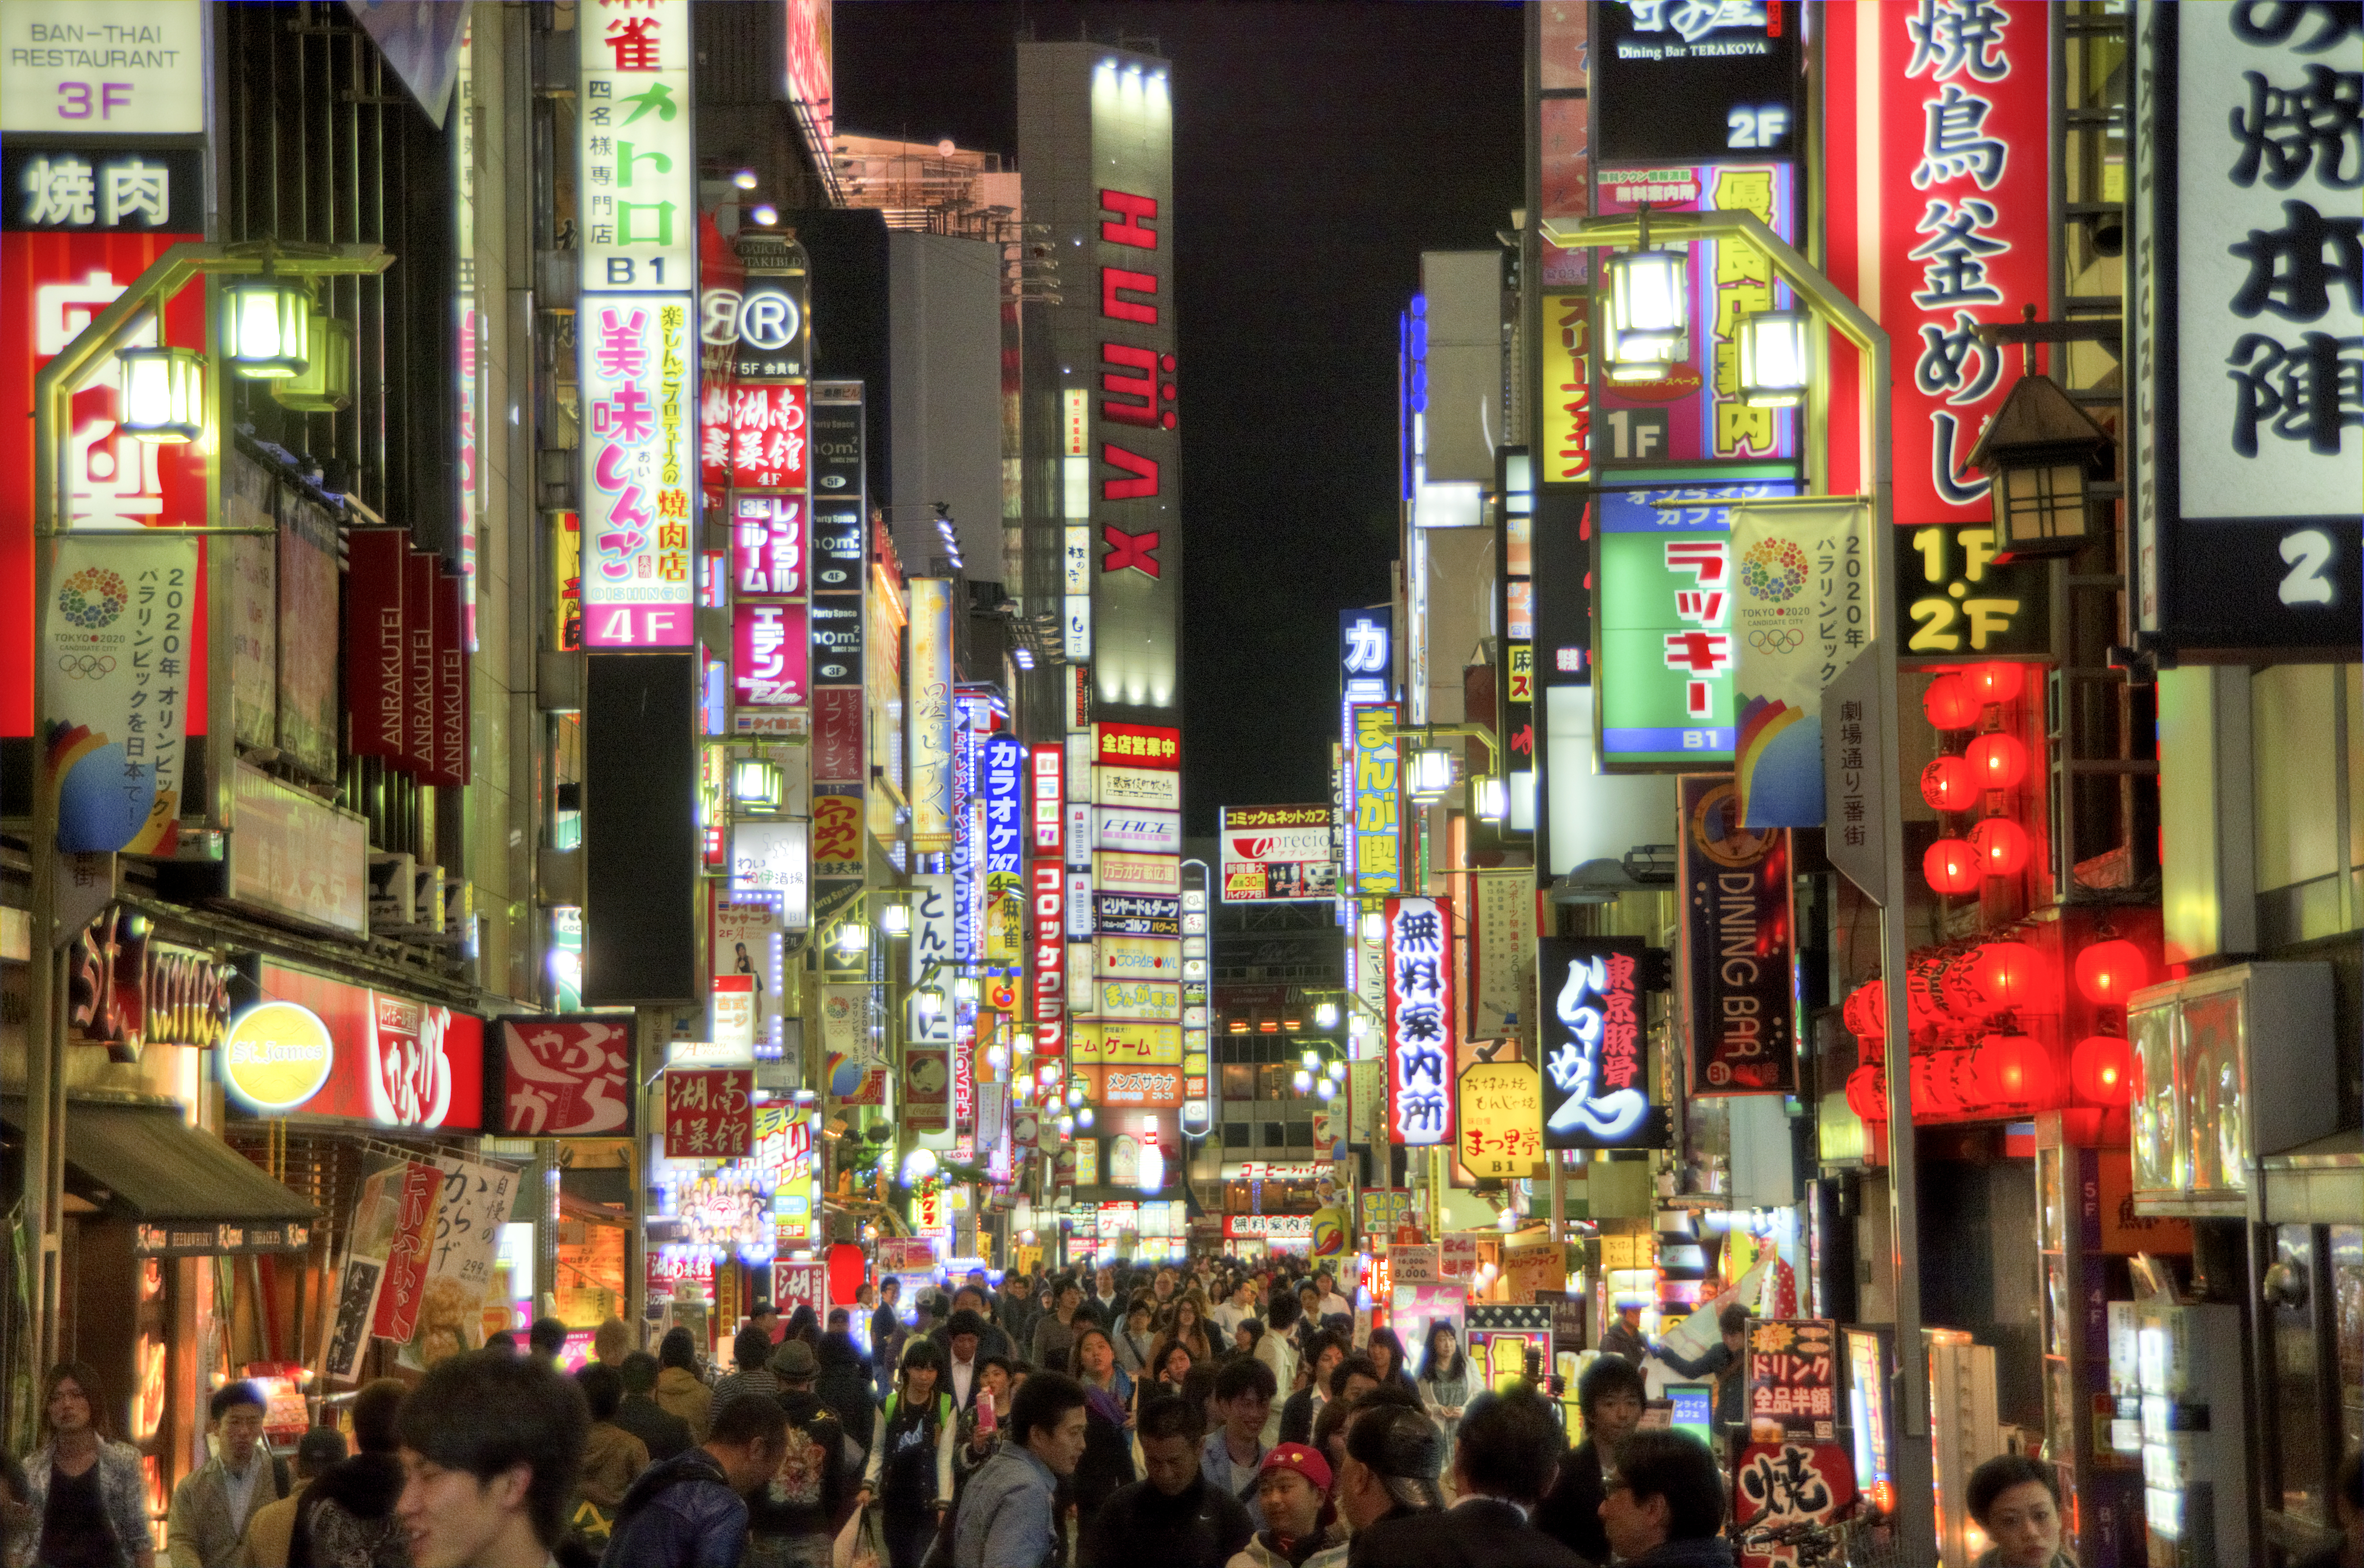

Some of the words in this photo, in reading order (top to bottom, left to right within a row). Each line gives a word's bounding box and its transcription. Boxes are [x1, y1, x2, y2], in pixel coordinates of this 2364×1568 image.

[599, 0, 663, 72] 雀
[12, 49, 179, 68] RESTAURANT
[1618, 45, 1662, 61] Dining
[1665, 45, 1686, 57] Bar
[1690, 43, 1766, 57] TERAKOYA
[58, 82, 134, 120] 3F
[1728, 113, 1784, 148] 2F
[589, 80, 613, 245] 四名様専門店
[29, 156, 170, 226] 焼肉
[1616, 184, 1696, 201] 無料案内所
[1904, 0, 2010, 506] 焼鳥釜めし
[607, 257, 665, 285] B1
[741, 363, 760, 375] 5F
[764, 363, 799, 375] 会員制
[592, 309, 655, 580] 美味しんご
[1608, 410, 1660, 457] 1F
[638, 451, 651, 477] おい
[757, 472, 782, 486] 4F
[827, 477, 840, 487] 5F
[832, 514, 857, 523] Space
[1507, 521, 1521, 531] 4F
[742, 522, 768, 592] ルーム
[772, 498, 799, 593] レンタル
[828, 572, 841, 580] 4F
[591, 587, 689, 600] OISHINGO
[1507, 586, 1522, 597] 3F
[837, 609, 857, 618] Space
[1741, 608, 1775, 618] TOKYO
[1786, 606, 1810, 617] 2020
[602, 609, 675, 643] 4F
[1908, 598, 2019, 651] 2F
[55, 634, 90, 644] TOKYO
[99, 634, 125, 643] 2020
[753, 608, 785, 678] エデン
[382, 608, 401, 746] ANRAKUTEI
[828, 667, 841, 675] 3F
[414, 629, 431, 762] ANRAKUTEI
[749, 681, 801, 704] Eden
[444, 649, 460, 777] ANRAKUTEI
[826, 691, 841, 778] リフレッシュ
[1102, 733, 1175, 758] 全店営業中
[1682, 730, 1717, 748] B1
[1839, 700, 1866, 847] 劇場通り一番街
[989, 742, 1017, 851] カラオケ
[1038, 758, 1057, 842] カラオケ
[1103, 819, 1177, 834] FACE
[1226, 809, 1331, 826] コミック&ネットカフ
[1075, 823, 1084, 859] MARUHAN
[737, 858, 766, 869] わい
[989, 853, 1018, 870] 747
[1104, 863, 1175, 881] カラオケ歌広場
[831, 882, 858, 903] Space
[718, 914, 773, 925] マッサージ
[789, 912, 803, 922] B1
[1075, 893, 1084, 929] MARUHAN
[1101, 898, 1178, 918] ビリヤード&ダーツ
[719, 930, 733, 938] 2F
[1003, 898, 1019, 948] 麻雀
[1125, 918, 1151, 932] ゴルフ
[1151, 921, 1178, 933] バグース
[1718, 872, 1758, 986] DINING
[1037, 869, 1062, 1044] コロッケクラブ
[1105, 984, 1176, 1007] まんが喫茶
[1395, 910, 1443, 1133] 無料案内所
[1601, 952, 1638, 1087] 東京豚骨
[1721, 996, 1762, 1058] BAR
[231, 1040, 324, 1064] St.James
[1105, 1036, 1151, 1056] ゲーム
[1107, 1072, 1176, 1091] メンズサウナ
[1475, 1096, 1537, 1111] もんじゃ焼
[1240, 1164, 1287, 1177] コーヒー
[1491, 1160, 1515, 1173] B1
[651, 1255, 713, 1279] 湖南菜館
[1753, 1354, 1831, 1382] ドリンク
[1754, 1386, 1832, 1416] 全品半額
